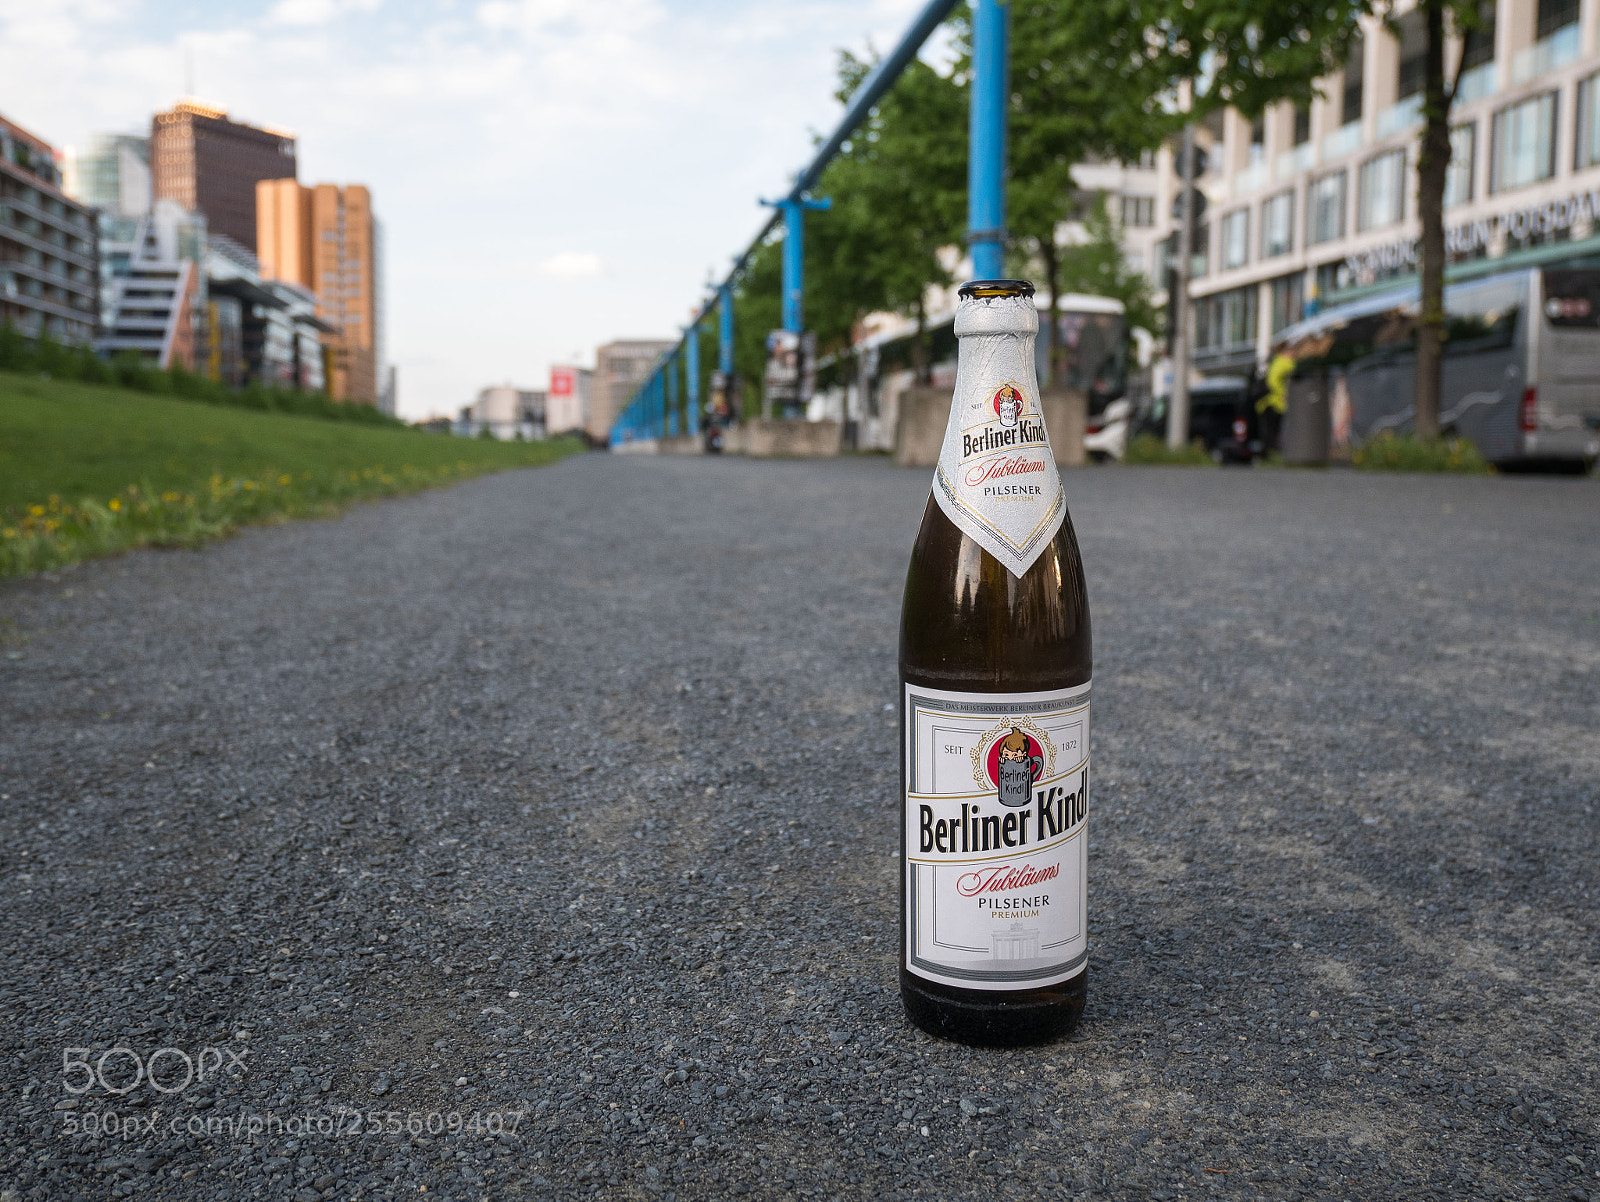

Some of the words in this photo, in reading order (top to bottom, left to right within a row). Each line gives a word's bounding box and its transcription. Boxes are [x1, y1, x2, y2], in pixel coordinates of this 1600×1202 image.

[963, 427, 1017, 457] Berliner
[984, 485, 1041, 496] PILSENER
[960, 704, 1008, 712] MEISTERWERK
[944, 744, 964, 755] SEIT
[1061, 739, 1077, 752] 1872
[1000, 766, 1029, 783] Berliner
[919, 803, 1031, 854] Berliner
[1037, 766, 1088, 842] Kindl
[978, 895, 1050, 909] PILSENER
[991, 909, 1039, 919] PREMIUM
